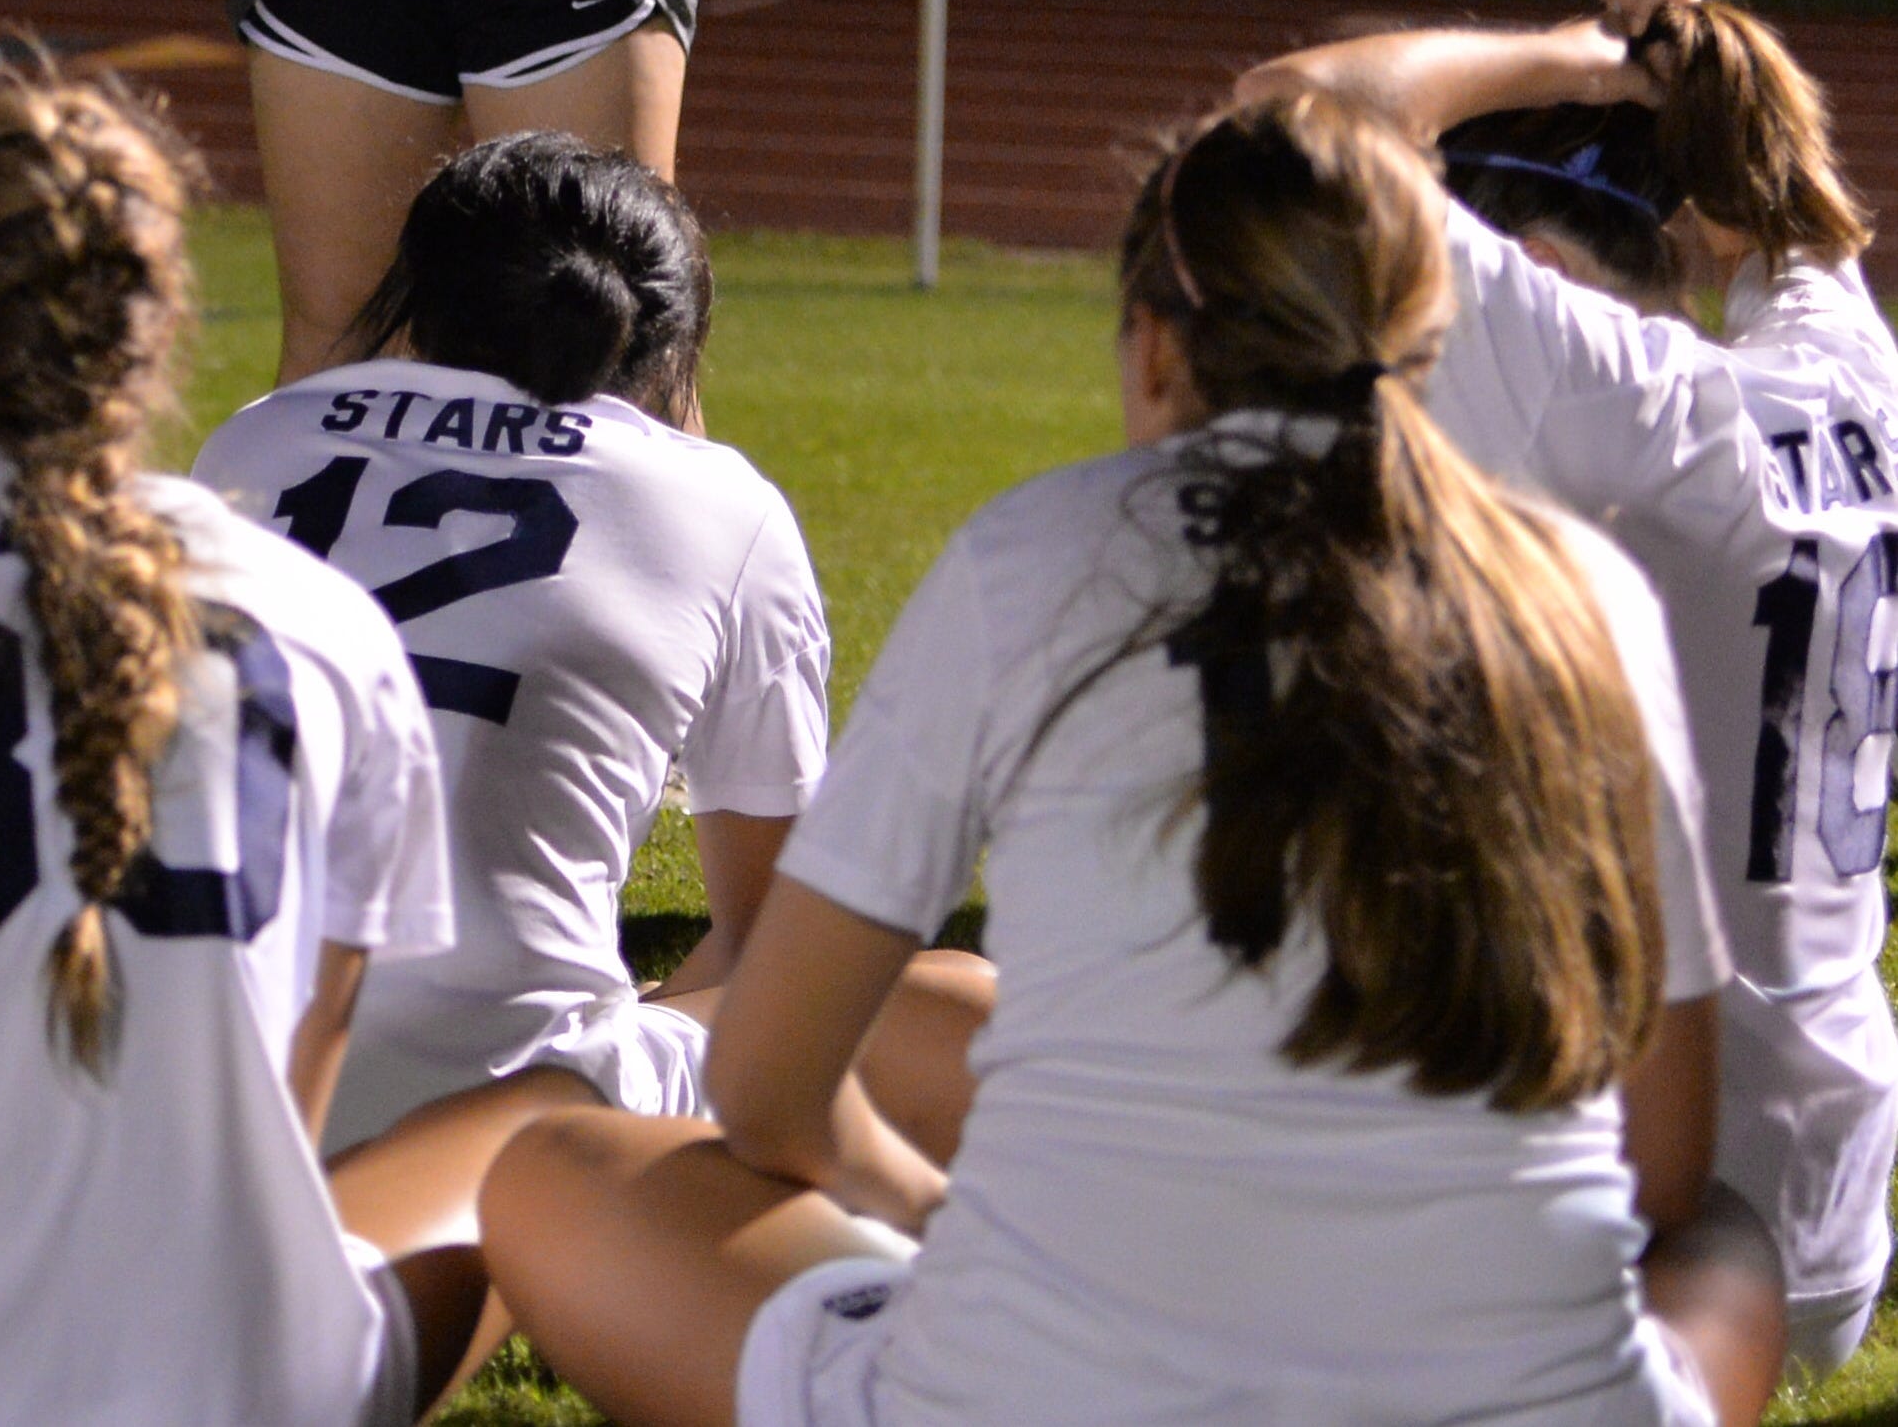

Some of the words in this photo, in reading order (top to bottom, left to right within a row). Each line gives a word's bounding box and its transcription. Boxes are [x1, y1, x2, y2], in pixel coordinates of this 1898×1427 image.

[320, 389, 593, 457] STARS
[272, 455, 580, 728] 12
[1746, 532, 1898, 882] 18
